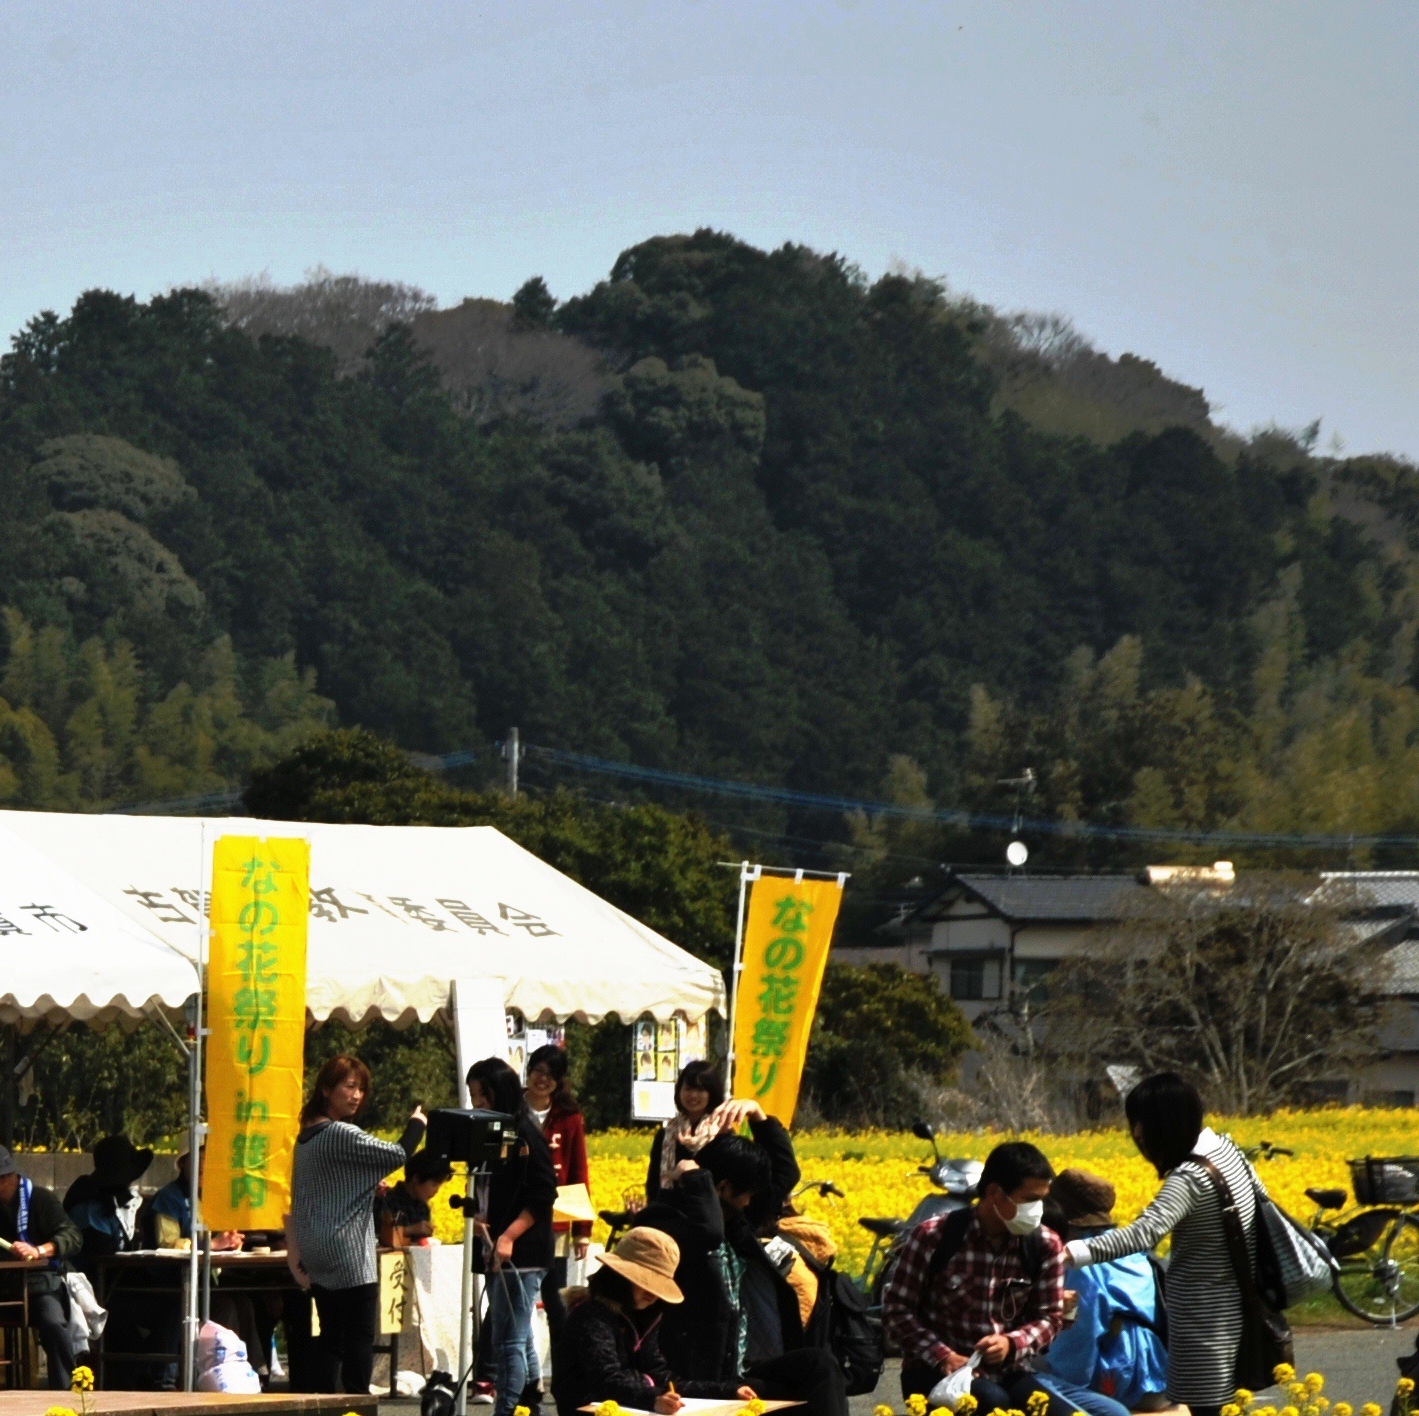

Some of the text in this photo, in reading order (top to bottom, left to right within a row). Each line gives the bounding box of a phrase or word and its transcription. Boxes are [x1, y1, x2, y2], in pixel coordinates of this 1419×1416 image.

[231, 855, 282, 1211] なの花祭り in 筵内
[751, 896, 809, 1098] なの花祭り
[387, 1259, 409, 1326] 受付
